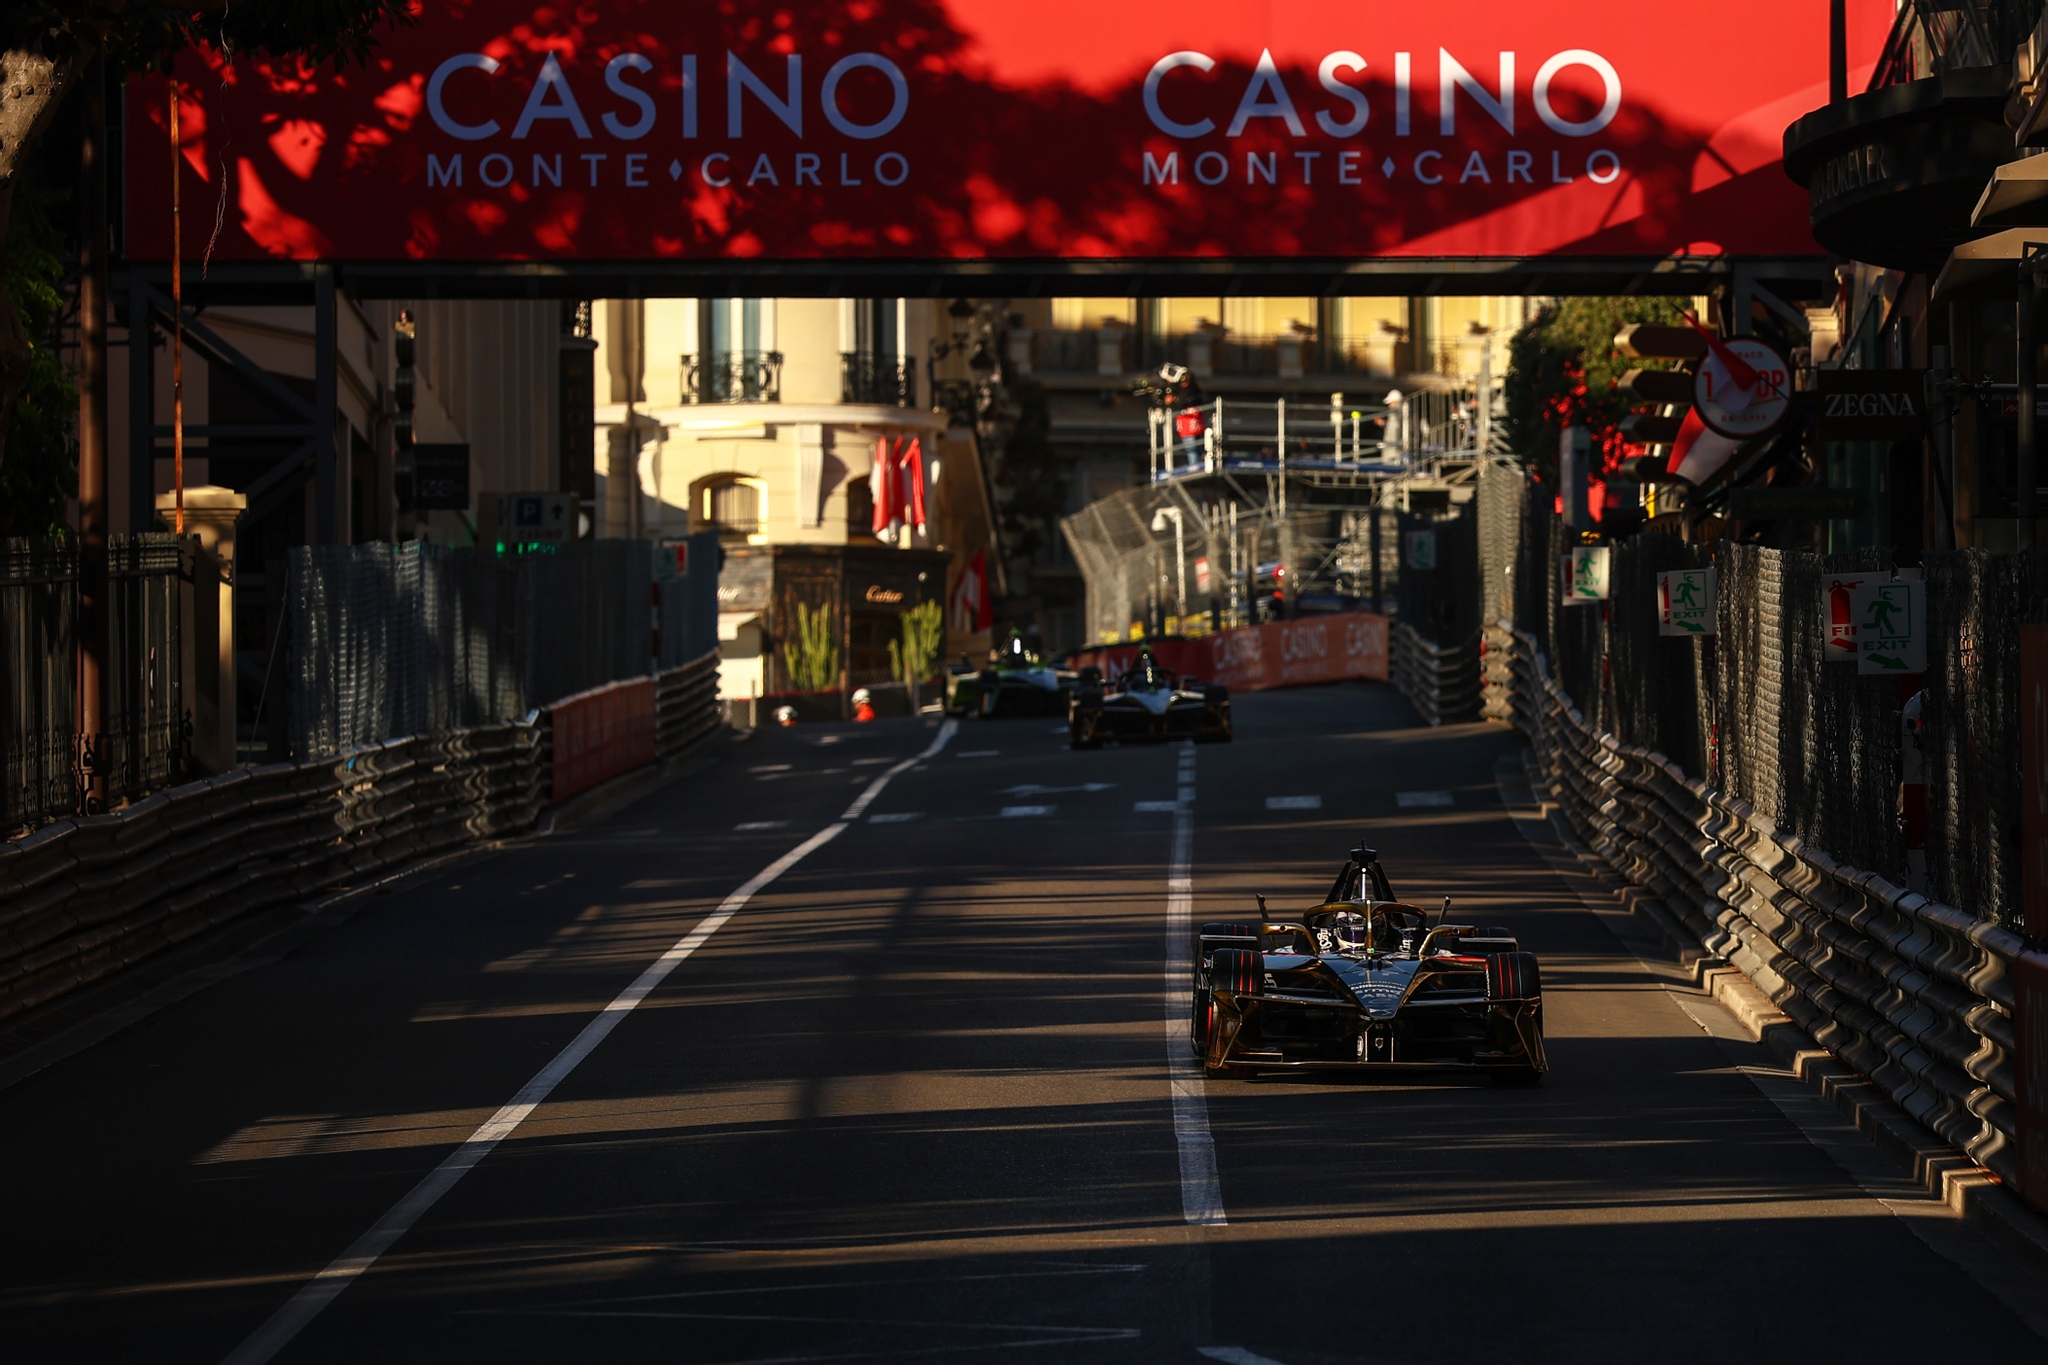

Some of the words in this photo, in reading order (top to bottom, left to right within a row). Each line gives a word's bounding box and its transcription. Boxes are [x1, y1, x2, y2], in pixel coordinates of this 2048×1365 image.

[426, 50, 910, 141] CASINO
[1141, 46, 1622, 140] CASINO
[427, 151, 650, 188] MONTE
[700, 151, 910, 188] CARLO
[1142, 150, 1363, 186] MONTE
[1412, 148, 1622, 185] CARLO
[1826, 142, 1891, 200] FOREVER
[1824, 391, 1917, 418] ZEGNA
[866, 584, 905, 604] Cartier
[1673, 610, 1708, 619] EXIT
[1280, 622, 1329, 662] CASINO
[1862, 639, 1911, 651] EXIT
